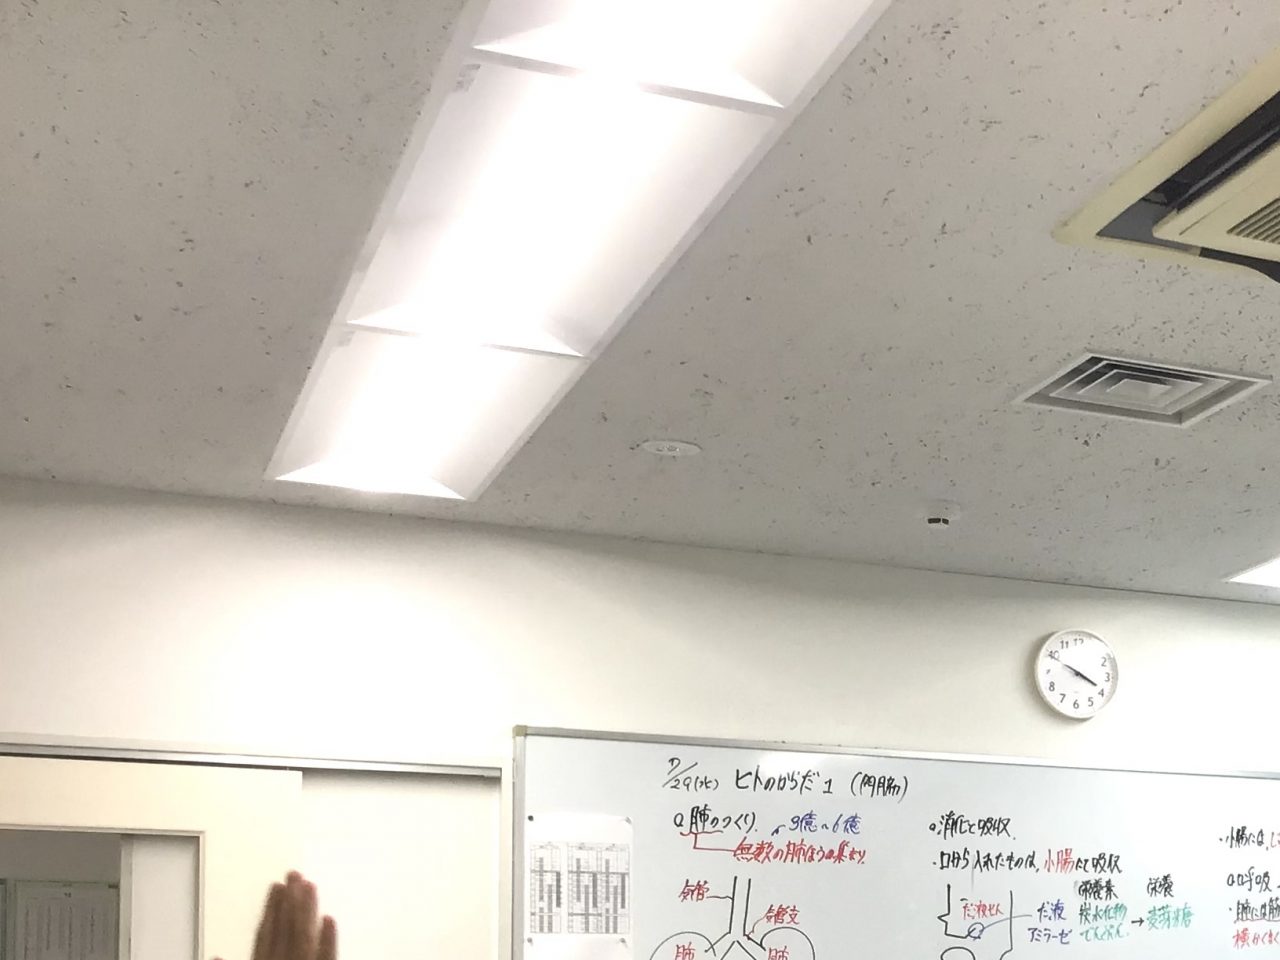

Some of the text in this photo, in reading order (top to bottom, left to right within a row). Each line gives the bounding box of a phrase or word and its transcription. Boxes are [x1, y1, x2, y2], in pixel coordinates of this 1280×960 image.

[1060, 640, 1070, 650] 11
[1101, 657, 1107, 667] 2
[1105, 672, 1111, 682] 3
[1048, 681, 1055, 692] 8
[1059, 693, 1067, 703] 7
[1097, 688, 1104, 698] 4
[1072, 699, 1080, 709] 6
[1087, 697, 1094, 707] 5
